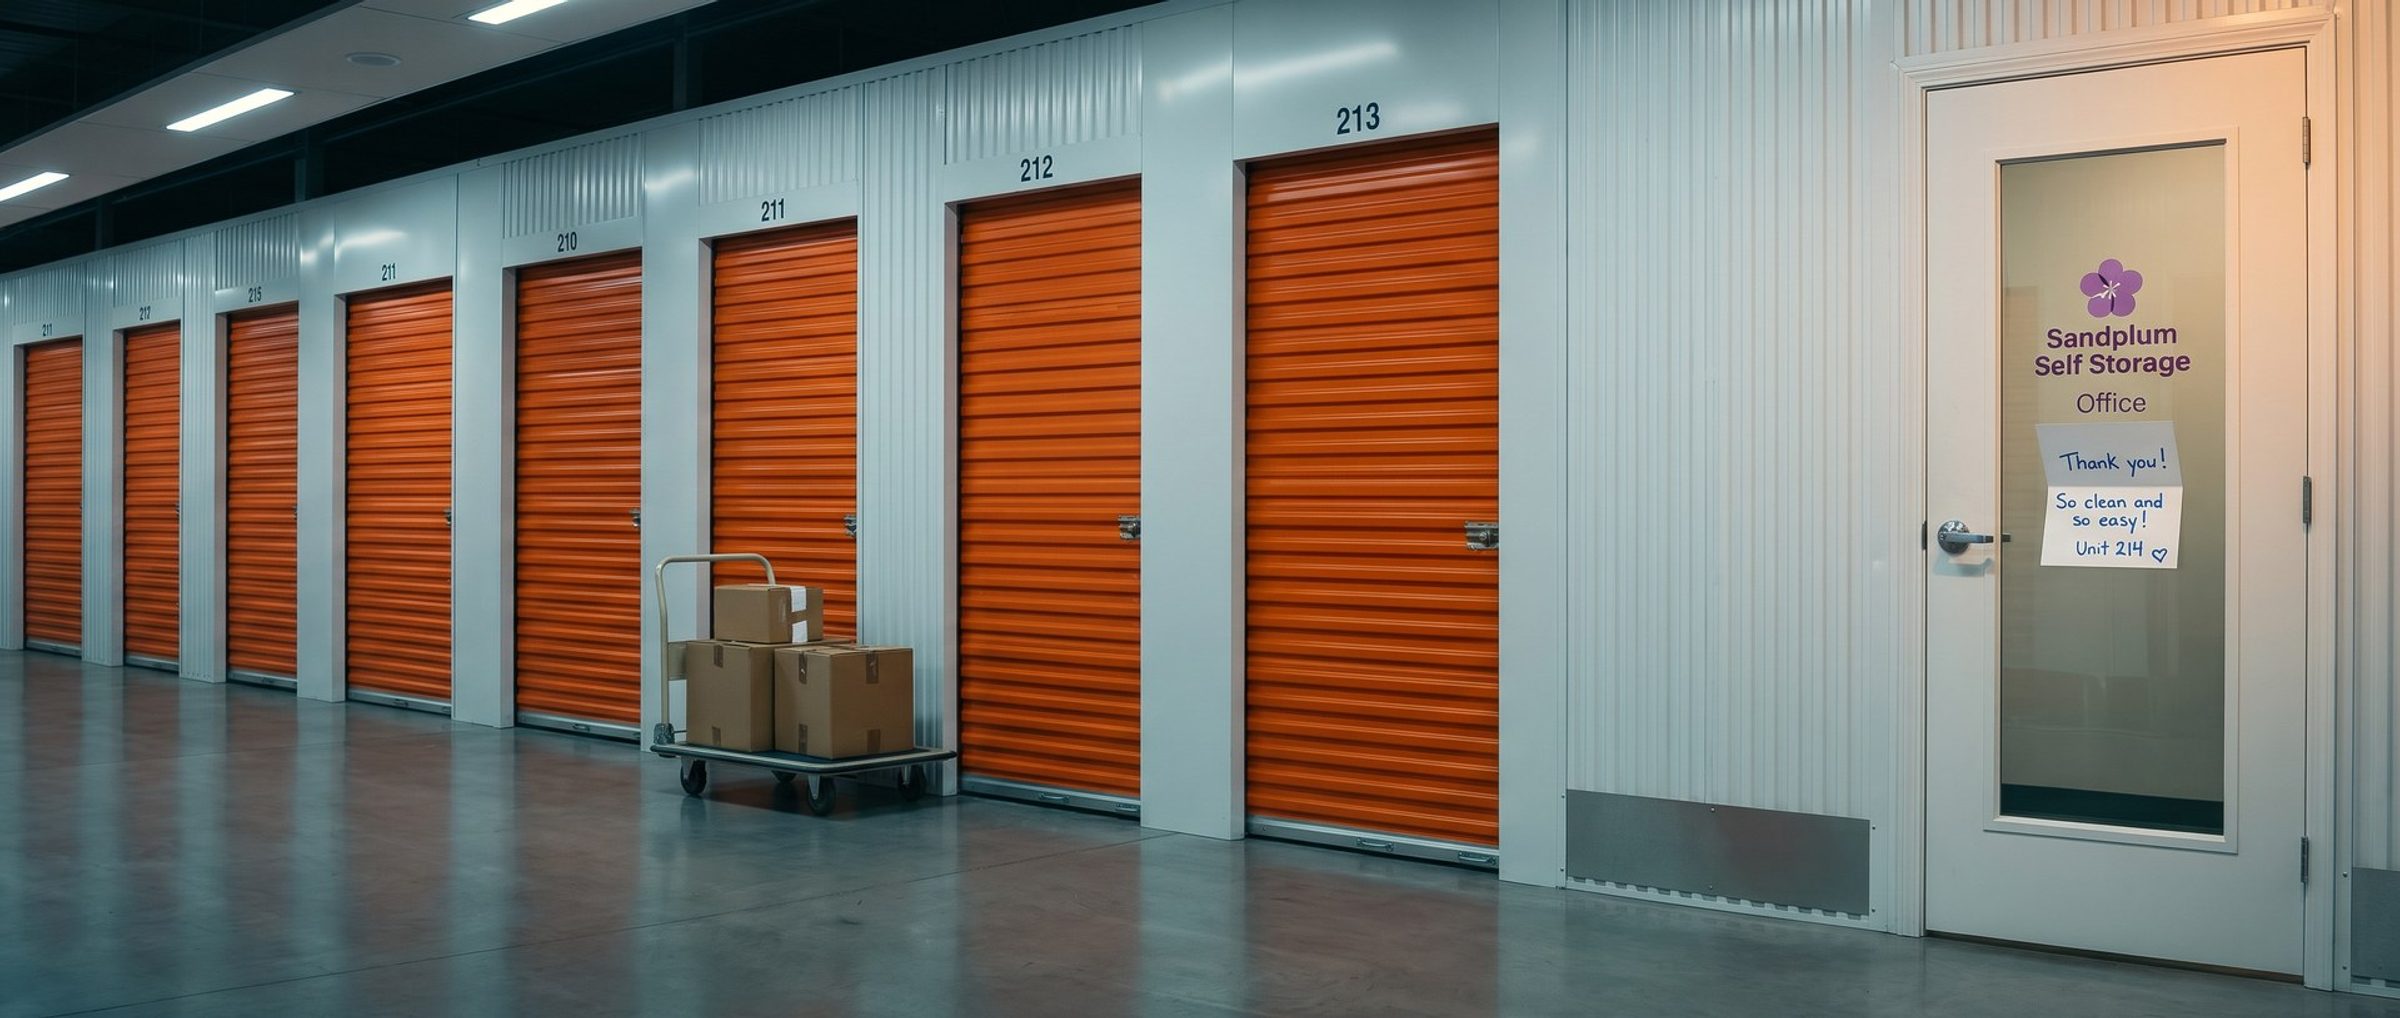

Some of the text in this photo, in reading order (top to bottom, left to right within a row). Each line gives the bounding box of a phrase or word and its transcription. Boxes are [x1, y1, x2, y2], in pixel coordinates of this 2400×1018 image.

[1336, 101, 1380, 136] 213
[1020, 154, 1054, 183] 212
[761, 197, 785, 222] 211
[557, 231, 578, 253] 210
[381, 262, 396, 282] 211
[2046, 324, 2177, 352] Sandplum
[2034, 353, 2191, 378] Self Storage
[2076, 391, 2147, 414] Office
[2058, 447, 2168, 478] Thank you!
[2056, 492, 2163, 510] So clean and
[2072, 510, 2147, 534] so easy!
[2076, 540, 2143, 557] Unit 214
